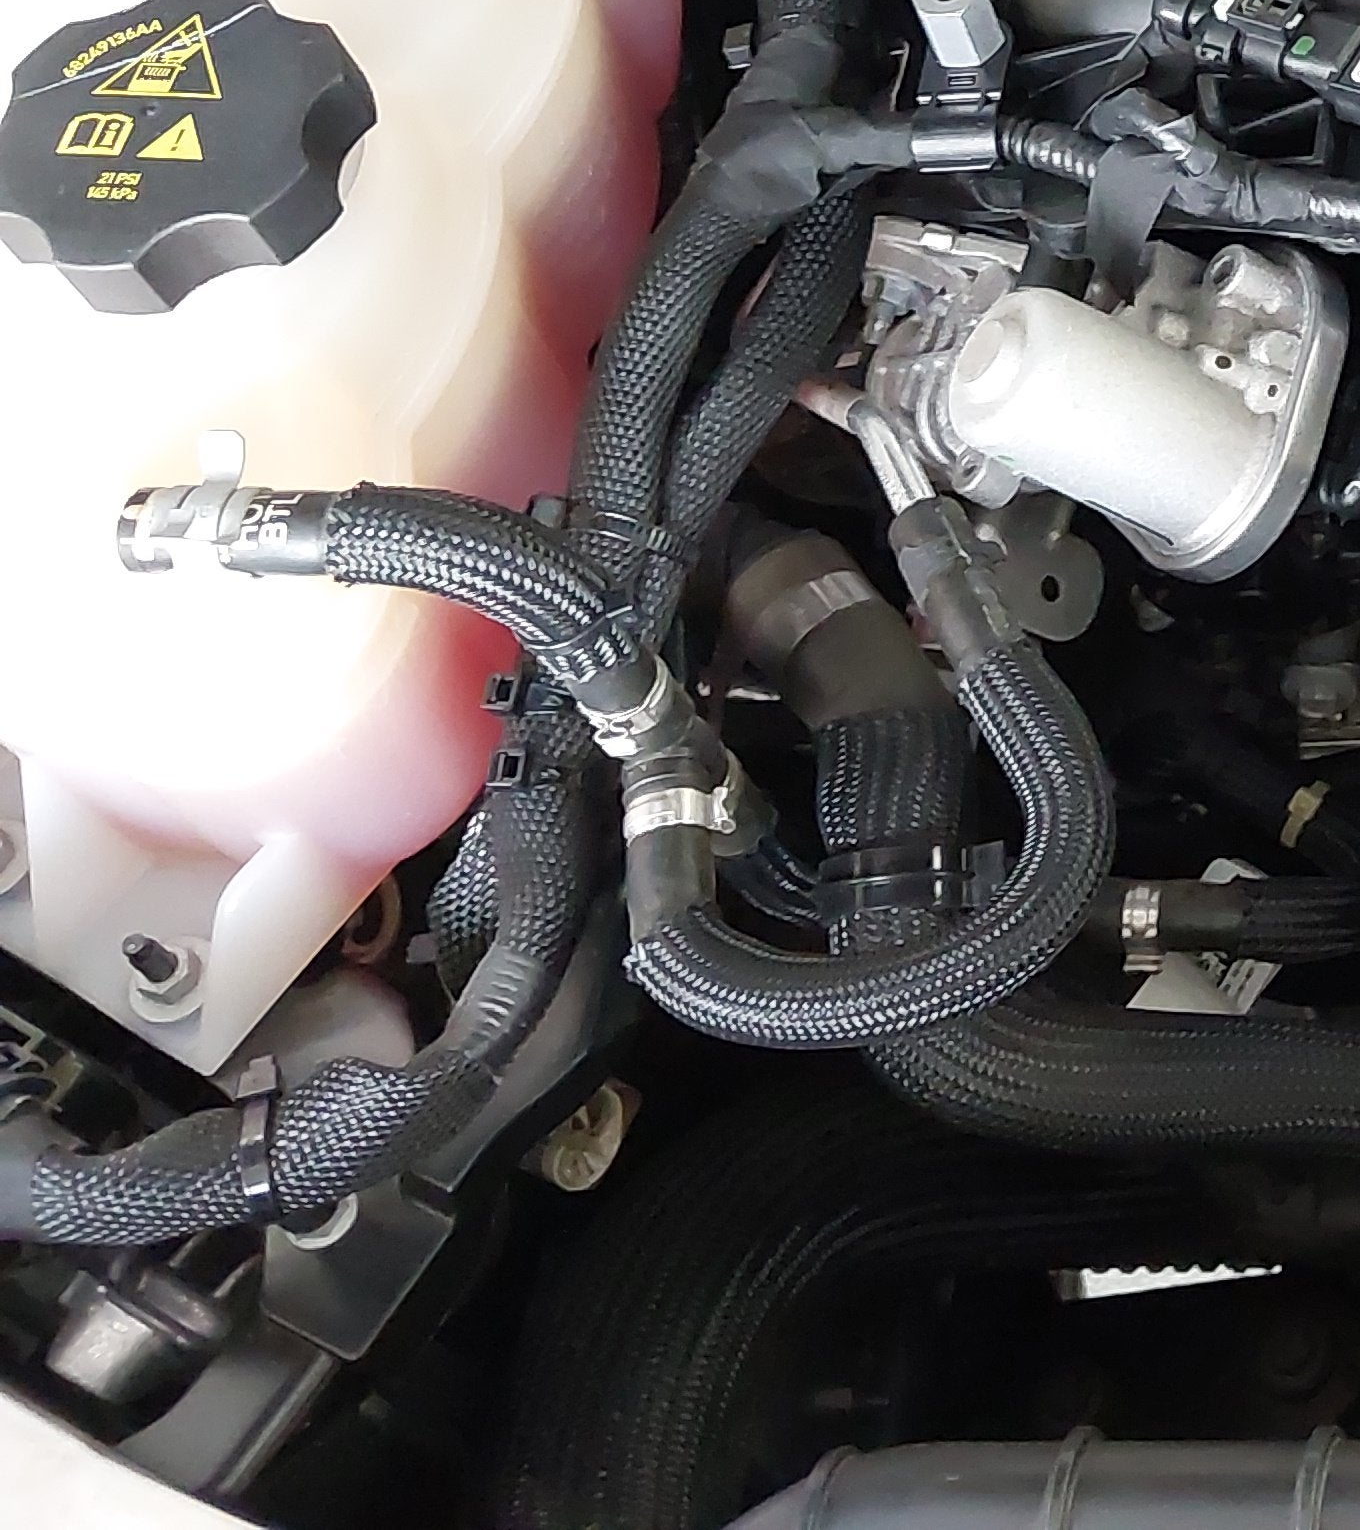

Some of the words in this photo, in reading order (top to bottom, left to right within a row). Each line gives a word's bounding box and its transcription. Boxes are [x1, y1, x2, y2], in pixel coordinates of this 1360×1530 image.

[62, 19, 165, 79] 68249136AA
[96, 171, 117, 185] 21
[113, 172, 143, 186] PSI
